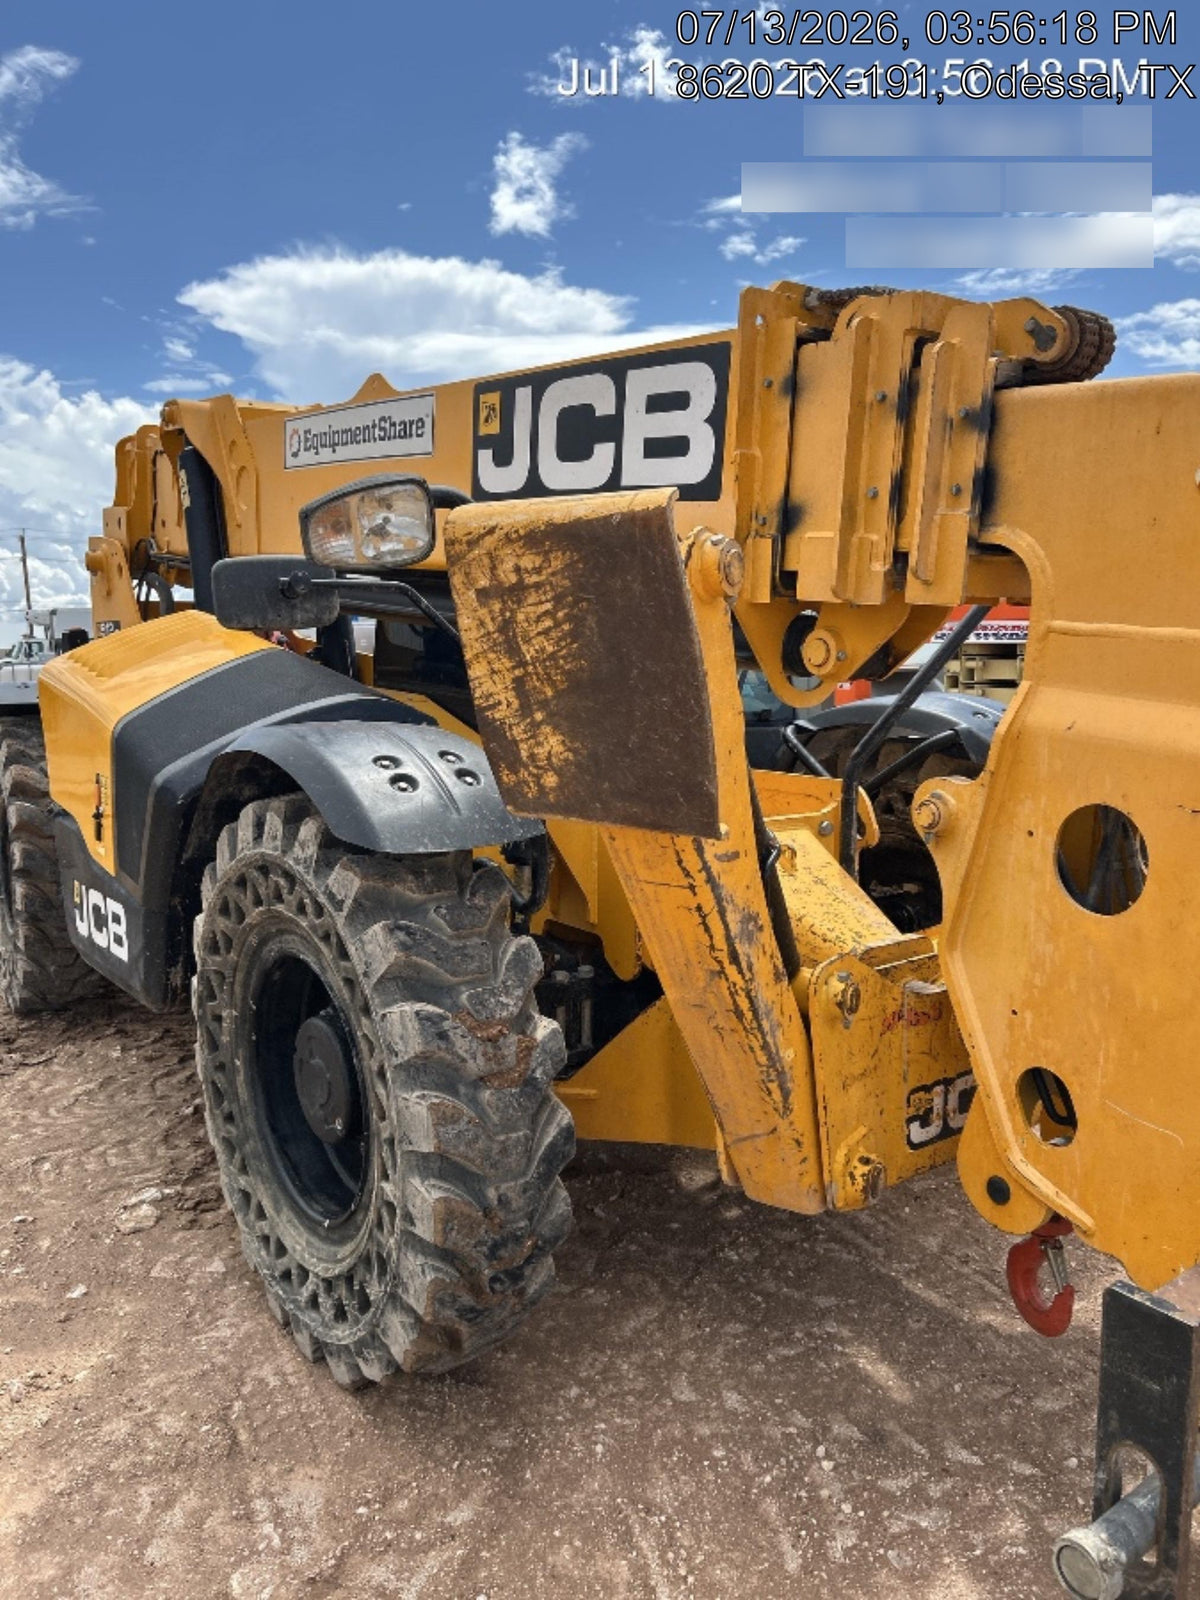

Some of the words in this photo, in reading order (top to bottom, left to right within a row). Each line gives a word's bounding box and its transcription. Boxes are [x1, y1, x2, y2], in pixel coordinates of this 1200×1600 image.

[303, 415, 426, 455] EquipmentShare
[477, 361, 717, 494] JCB
[73, 884, 129, 963] JCB
[908, 1073, 978, 1145] JC
